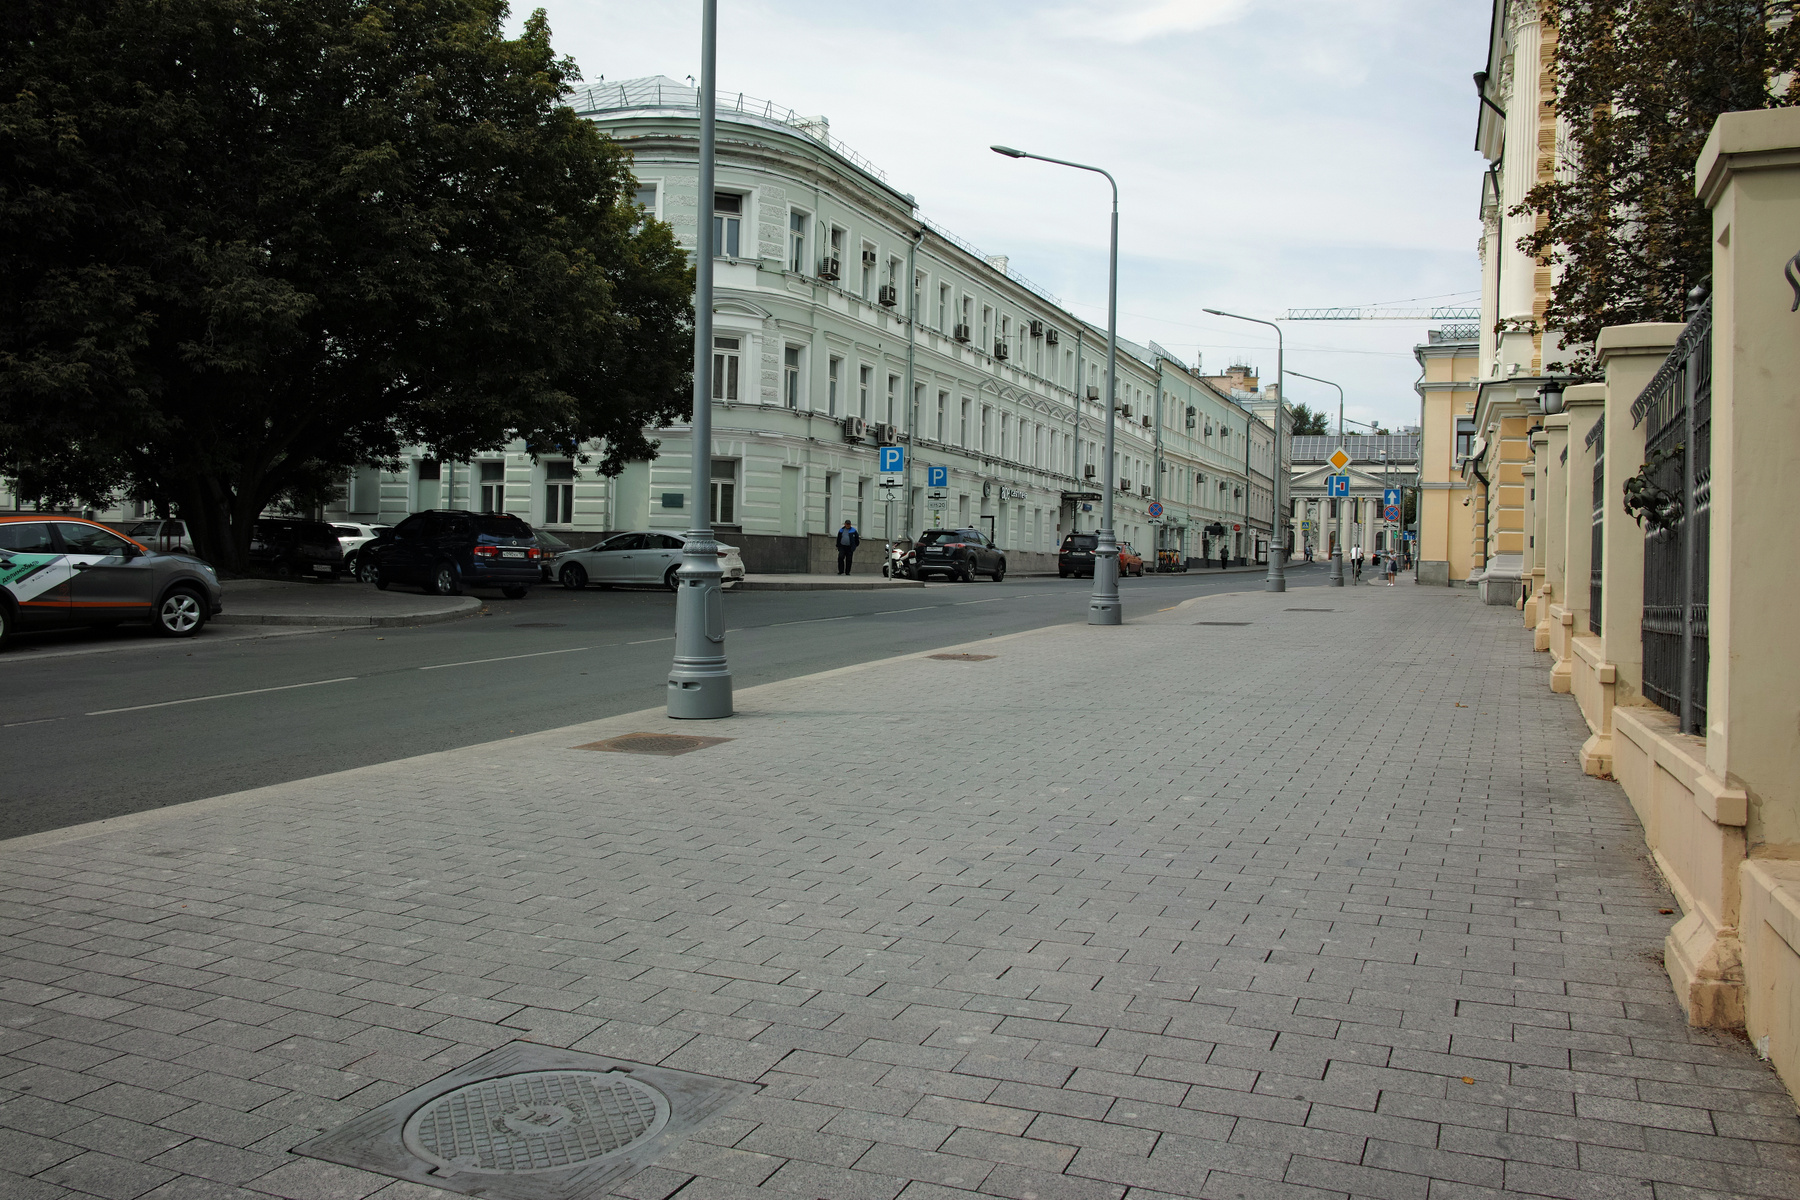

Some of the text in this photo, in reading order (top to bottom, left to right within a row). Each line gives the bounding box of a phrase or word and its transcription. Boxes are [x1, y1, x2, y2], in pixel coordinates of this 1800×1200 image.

[886, 450, 899, 470] P
[933, 469, 944, 485] P
[2, 560, 40, 584] делимобиль
